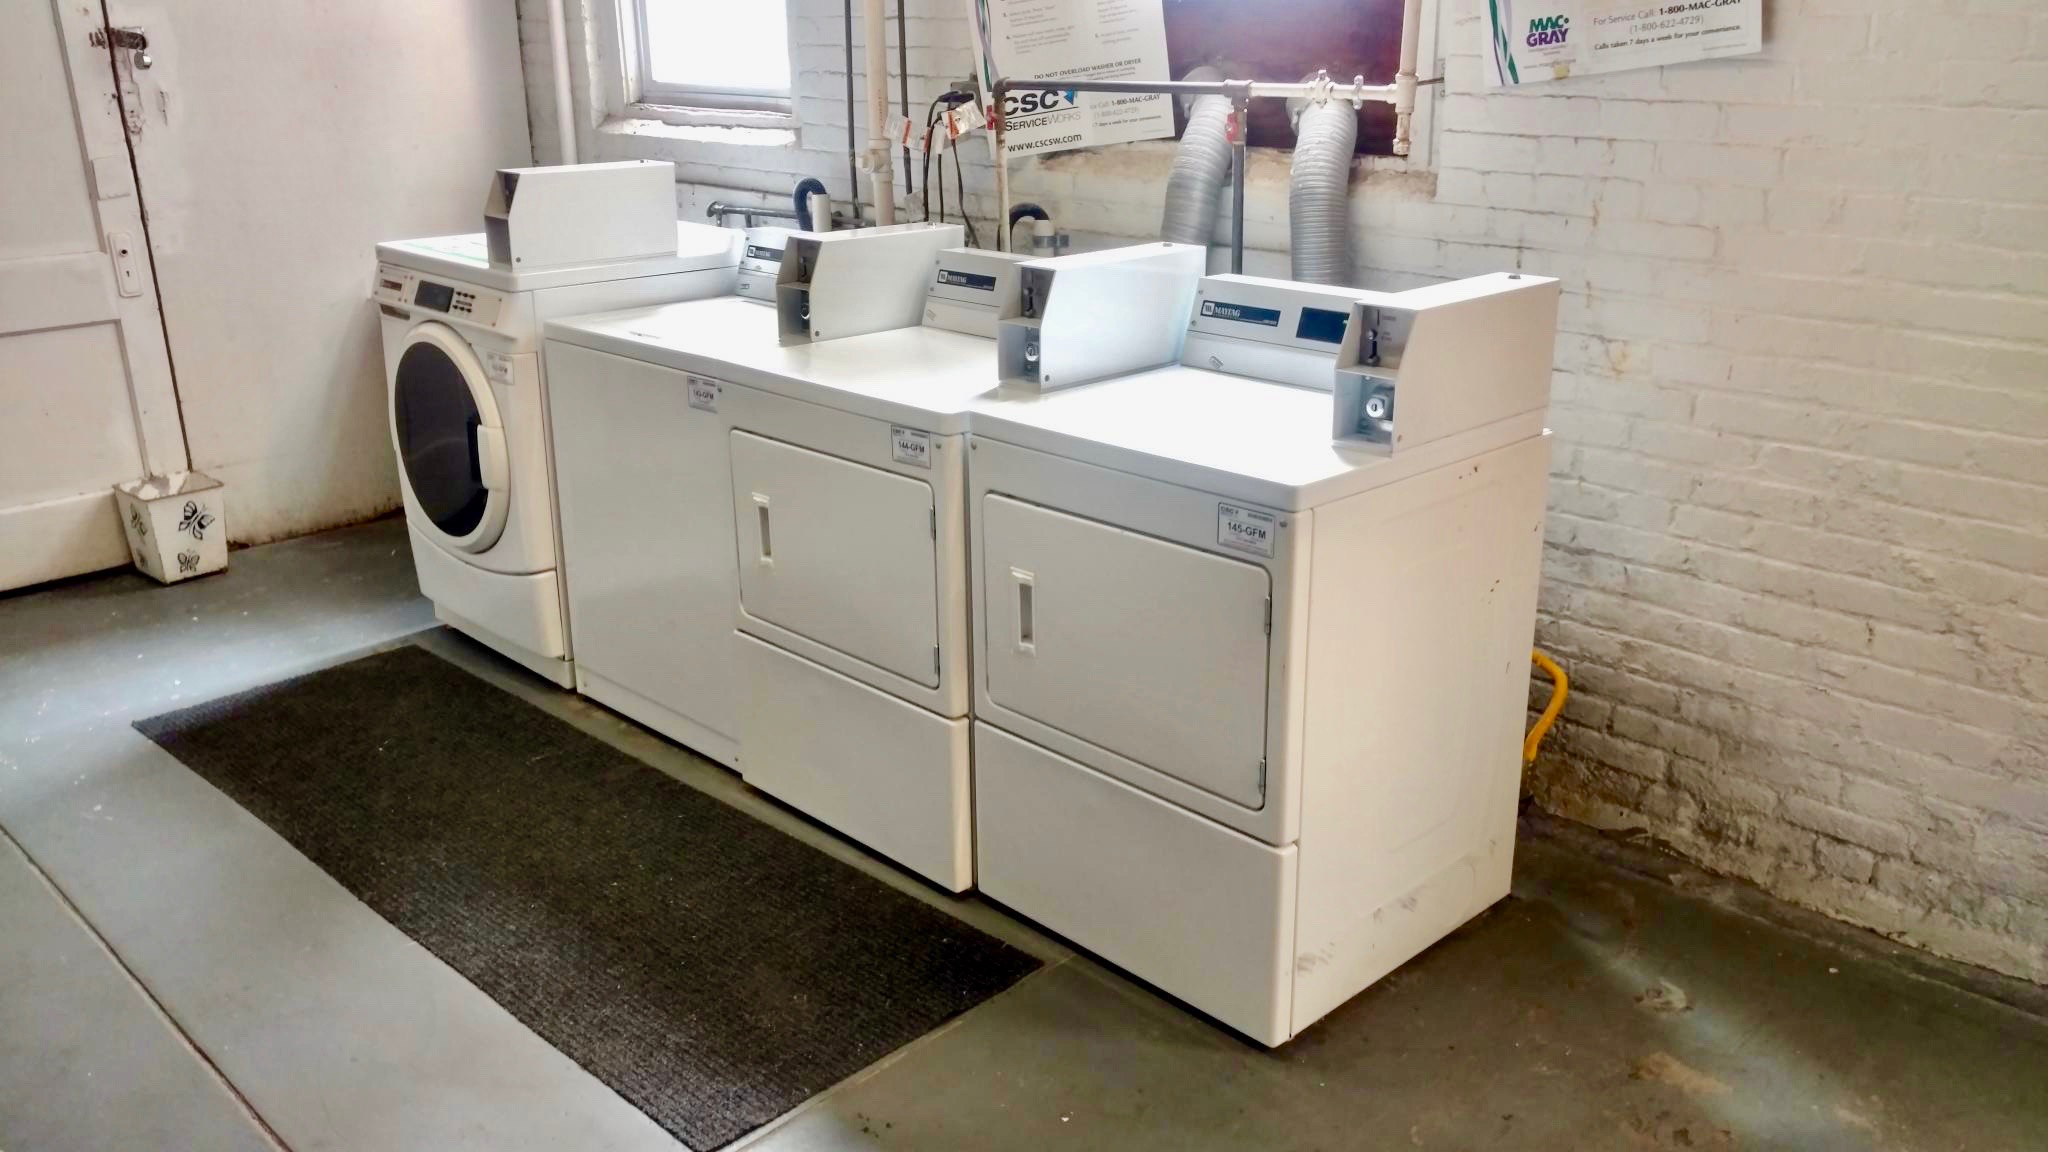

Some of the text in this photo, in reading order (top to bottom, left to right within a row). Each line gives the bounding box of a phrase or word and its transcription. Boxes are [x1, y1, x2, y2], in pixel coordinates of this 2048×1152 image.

[1593, 17, 1606, 26] For
[1608, 14, 1636, 24] Service
[1526, 28, 1569, 47] GRAY
[1594, 42, 1609, 50] Calls
[1635, 38, 1650, 46] days
[1060, 67, 1091, 76] OVERLOAD
[1091, 62, 1114, 71] WASHER
[1003, 89, 1060, 117] CSC
[1007, 134, 1082, 152] www.cscsw.com
[1228, 521, 1266, 540] 145-GFM
